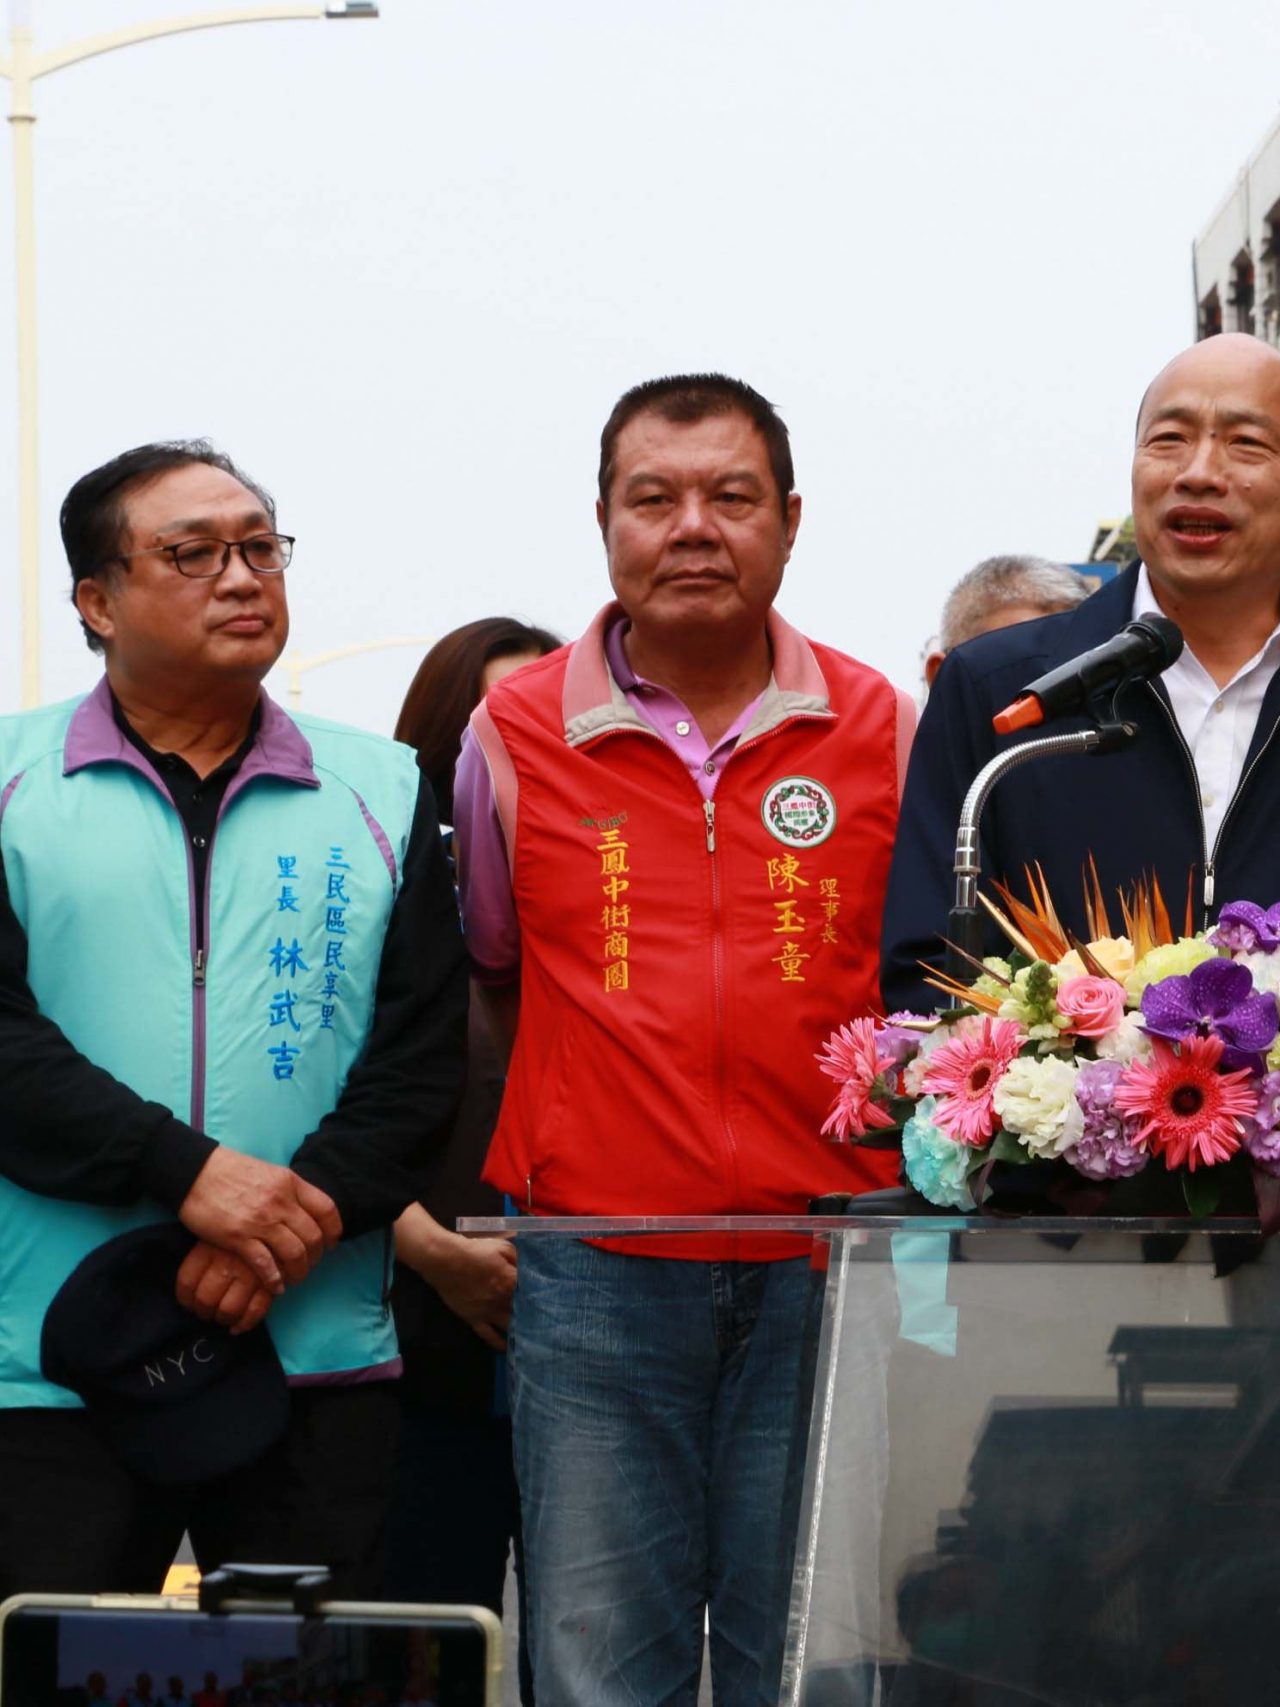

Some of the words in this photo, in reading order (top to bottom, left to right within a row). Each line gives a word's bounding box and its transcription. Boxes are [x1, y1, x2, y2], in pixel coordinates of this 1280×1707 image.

[277, 855, 300, 912] 里長
[320, 847, 350, 1029] 三民區民享里
[597, 829, 631, 993] 三鳳中街商圈
[767, 853, 811, 982] 陳玉童
[819, 878, 841, 944] 理事長
[267, 937, 310, 1081] 林武吉
[144, 1339, 215, 1387] NYC
